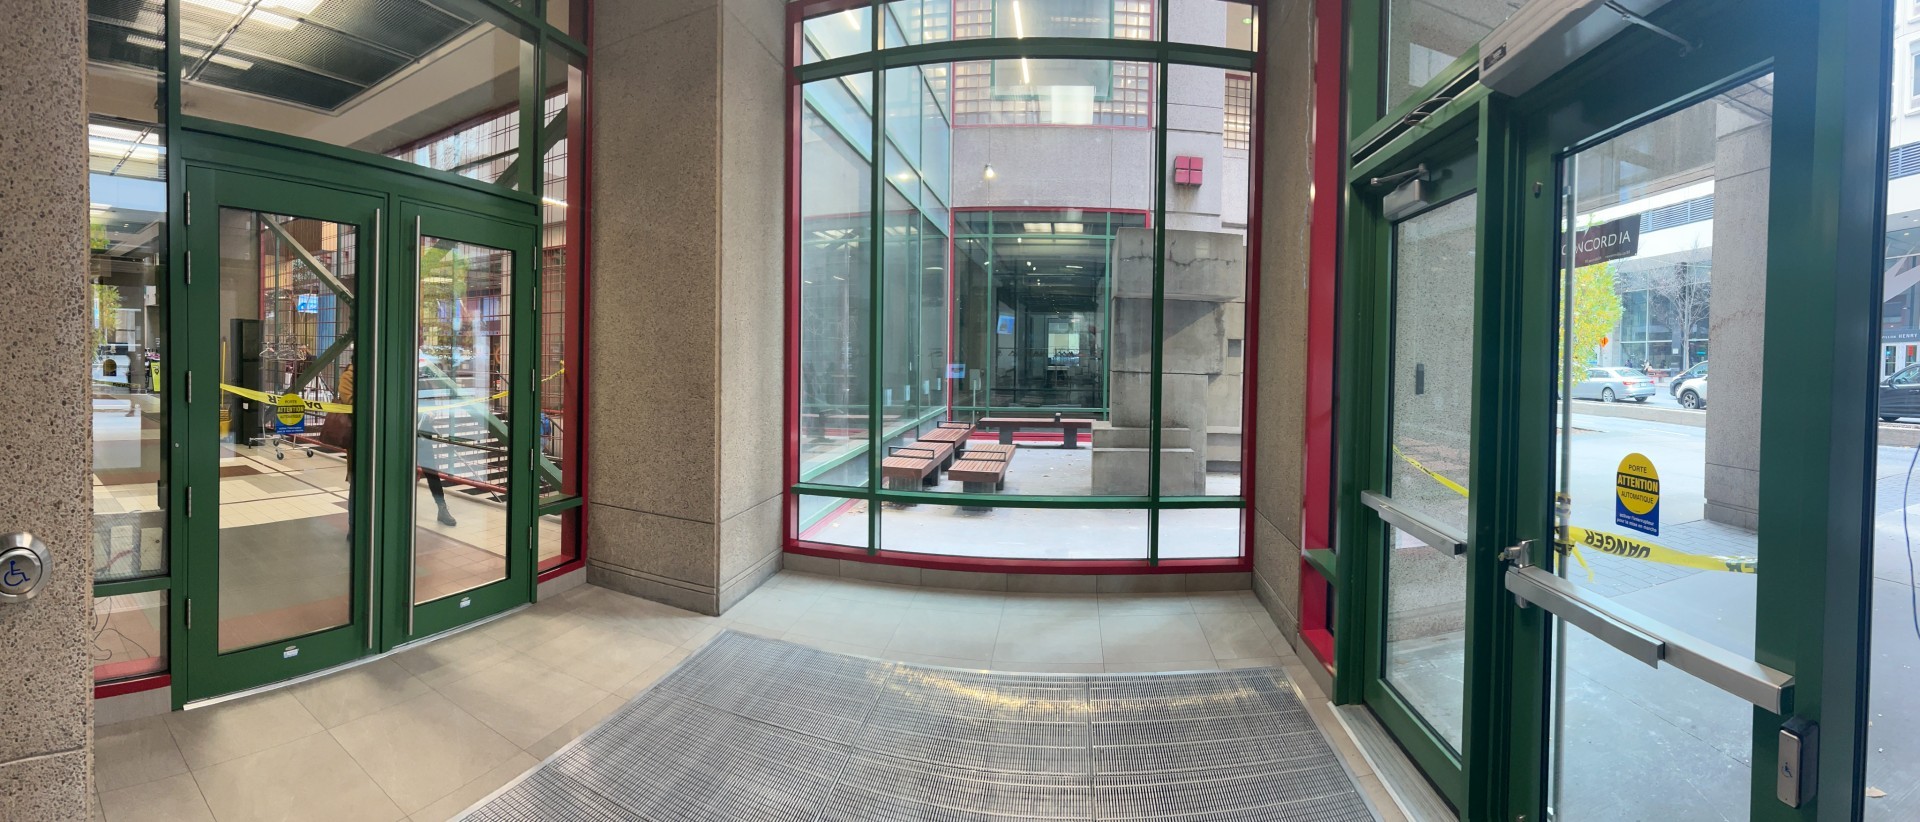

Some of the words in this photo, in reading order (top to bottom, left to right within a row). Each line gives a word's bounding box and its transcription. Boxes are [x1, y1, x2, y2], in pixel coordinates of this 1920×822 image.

[1561, 230, 1631, 256] CNCORDIA
[1628, 464, 1647, 474] PORTE
[1617, 474, 1659, 493] ATTENTION
[1621, 490, 1654, 505] AUTOMATIQUE
[1584, 529, 1651, 559] DANGER
